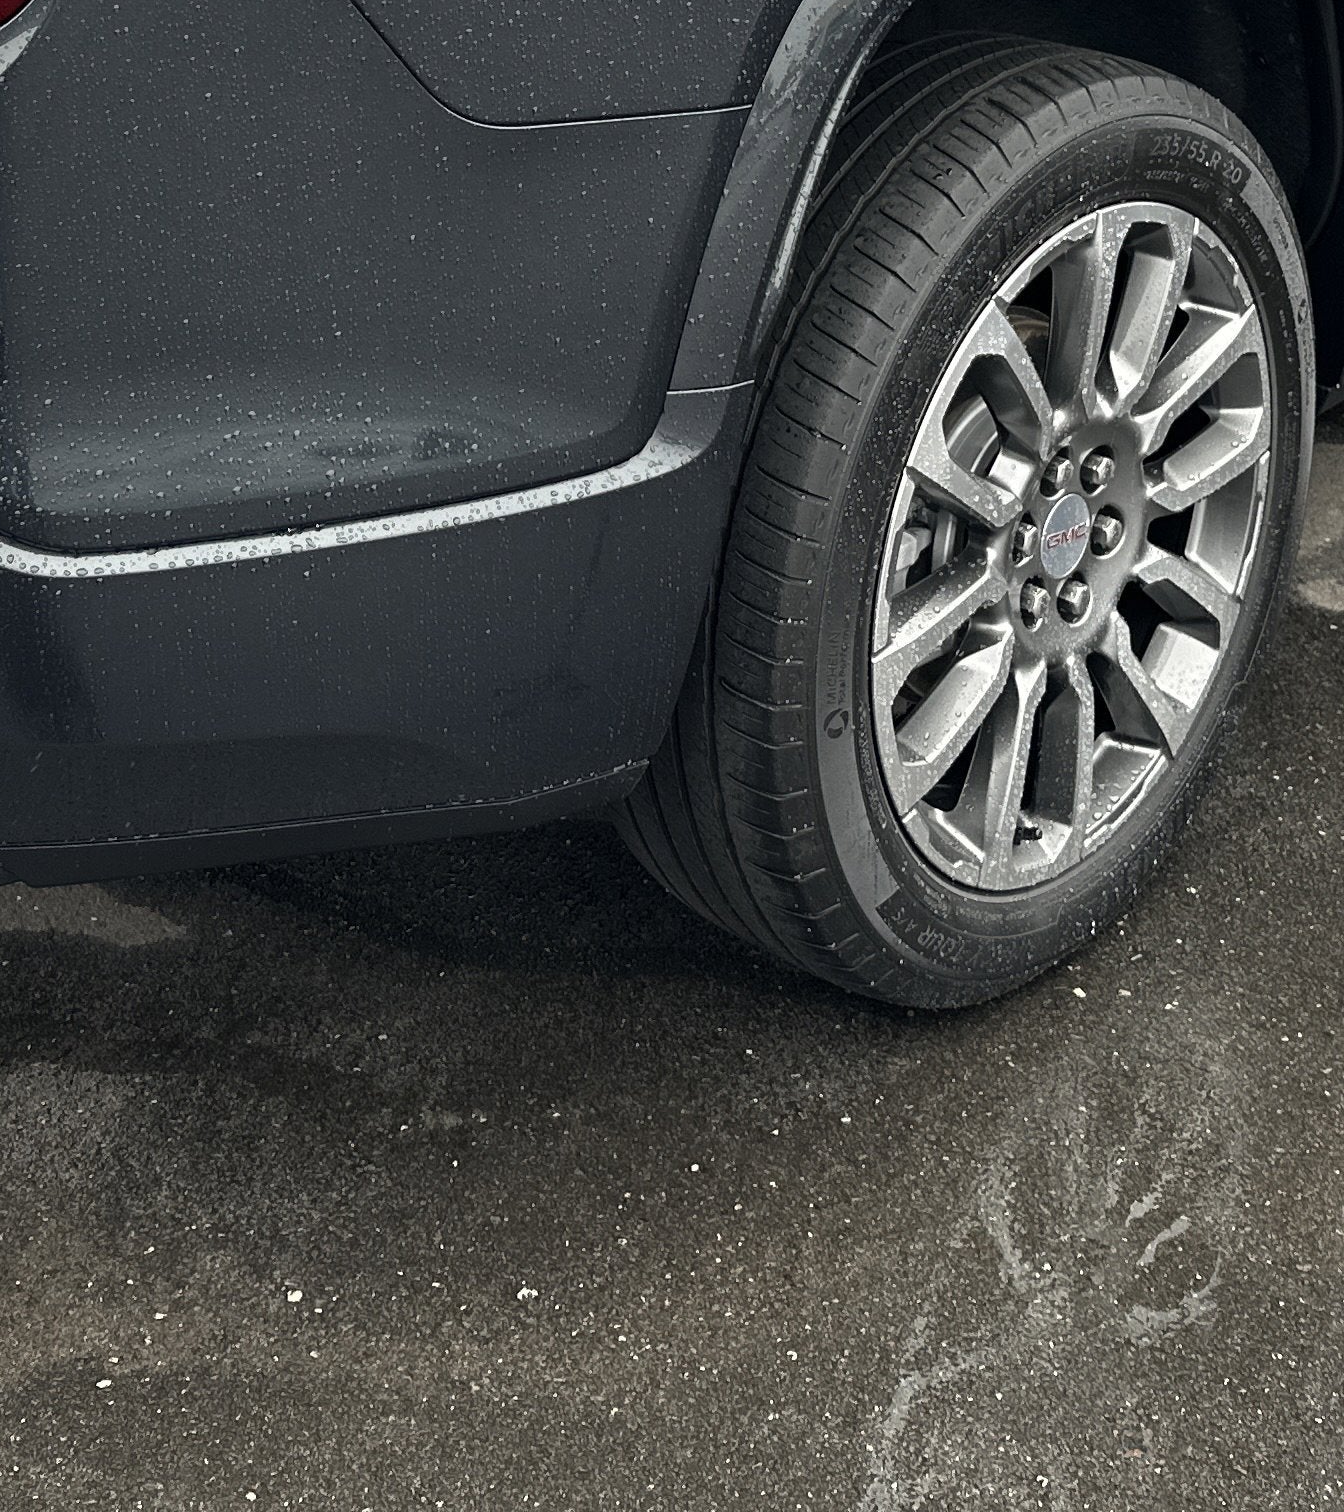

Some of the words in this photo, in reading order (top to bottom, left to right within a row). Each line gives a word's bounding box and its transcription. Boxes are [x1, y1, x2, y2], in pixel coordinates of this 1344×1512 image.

[1149, 134, 1207, 163] 235/55
[1222, 161, 1243, 185] 20
[1047, 521, 1088, 550] GMC
[825, 632, 840, 705] MICHELIN
[917, 924, 966, 960] TOUR
